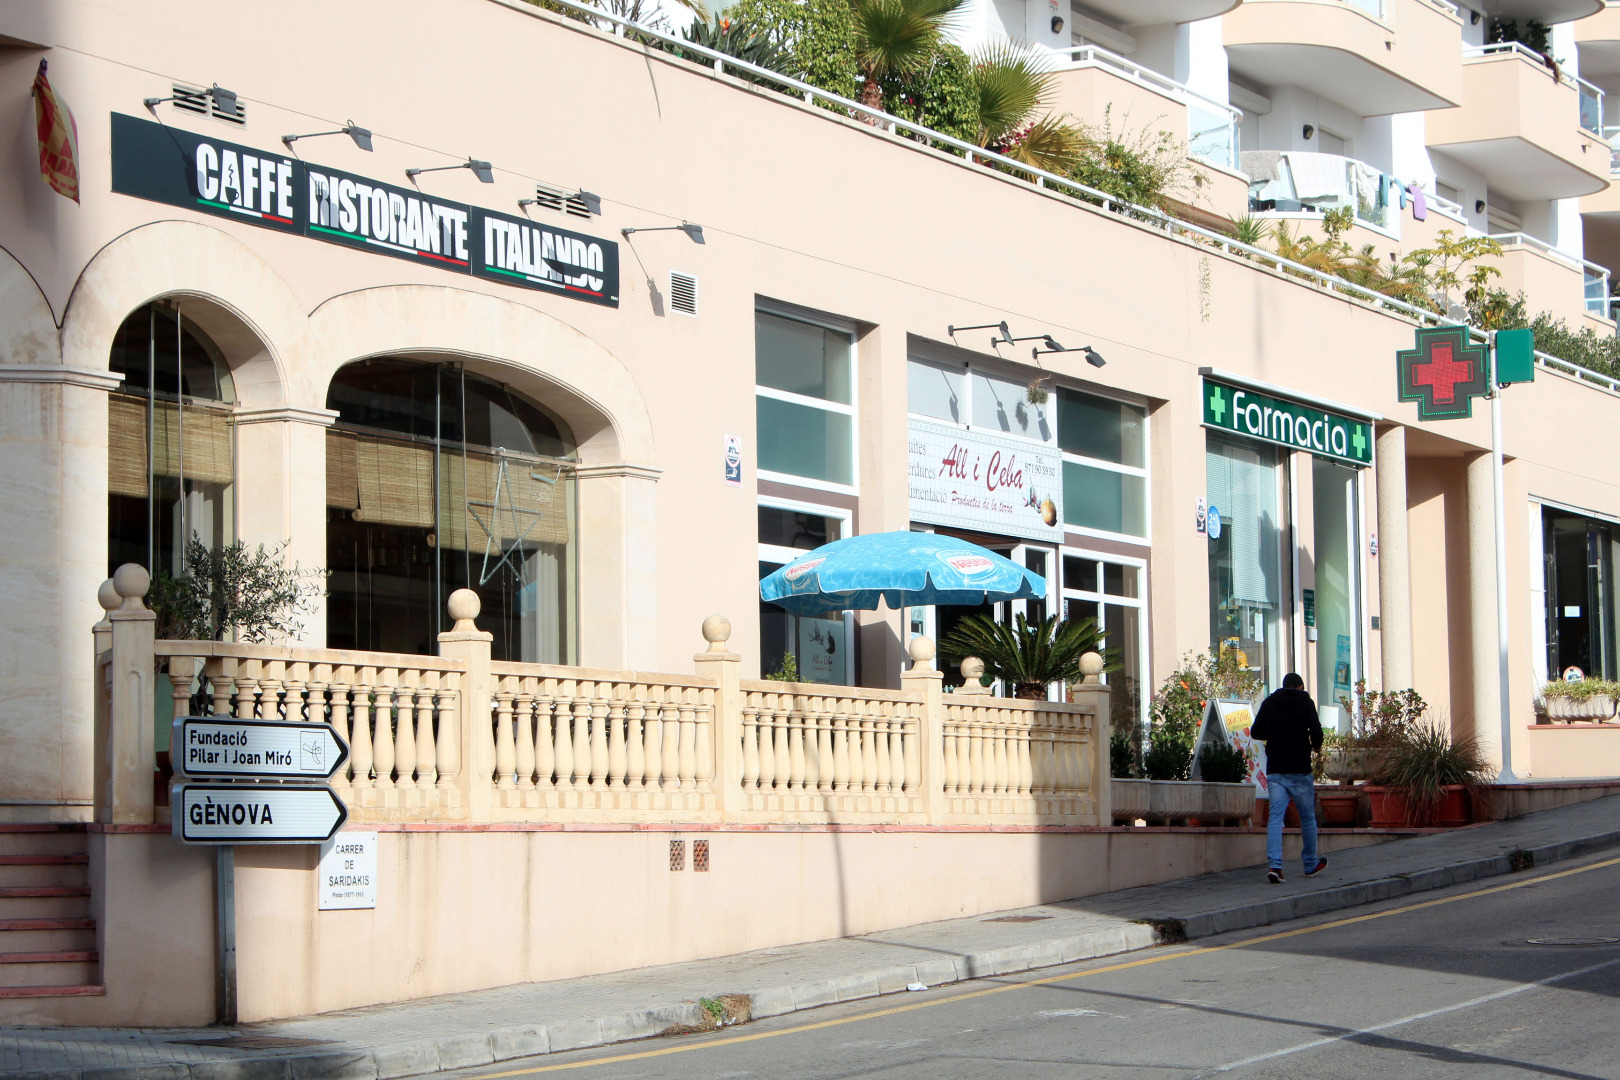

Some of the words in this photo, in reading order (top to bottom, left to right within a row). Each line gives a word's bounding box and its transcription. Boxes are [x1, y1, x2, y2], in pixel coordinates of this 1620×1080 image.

[309, 171, 469, 261] RISTORANTE
[484, 215, 604, 292] ITALIANDO
[1232, 391, 1347, 456] Farmacia
[939, 443, 968, 479] All
[973, 455, 980, 482] i
[986, 450, 1023, 491] Ceba
[189, 730, 248, 746] Fundació
[189, 748, 219, 764] Pilar
[224, 750, 228, 764] i
[233, 750, 261, 765] Joan
[265, 750, 292, 766] Miró
[189, 796, 273, 825] GÈNOVA
[335, 844, 364, 855] CARRER
[344, 859, 354, 870] DE
[328, 875, 370, 887] SARIDAKIS
